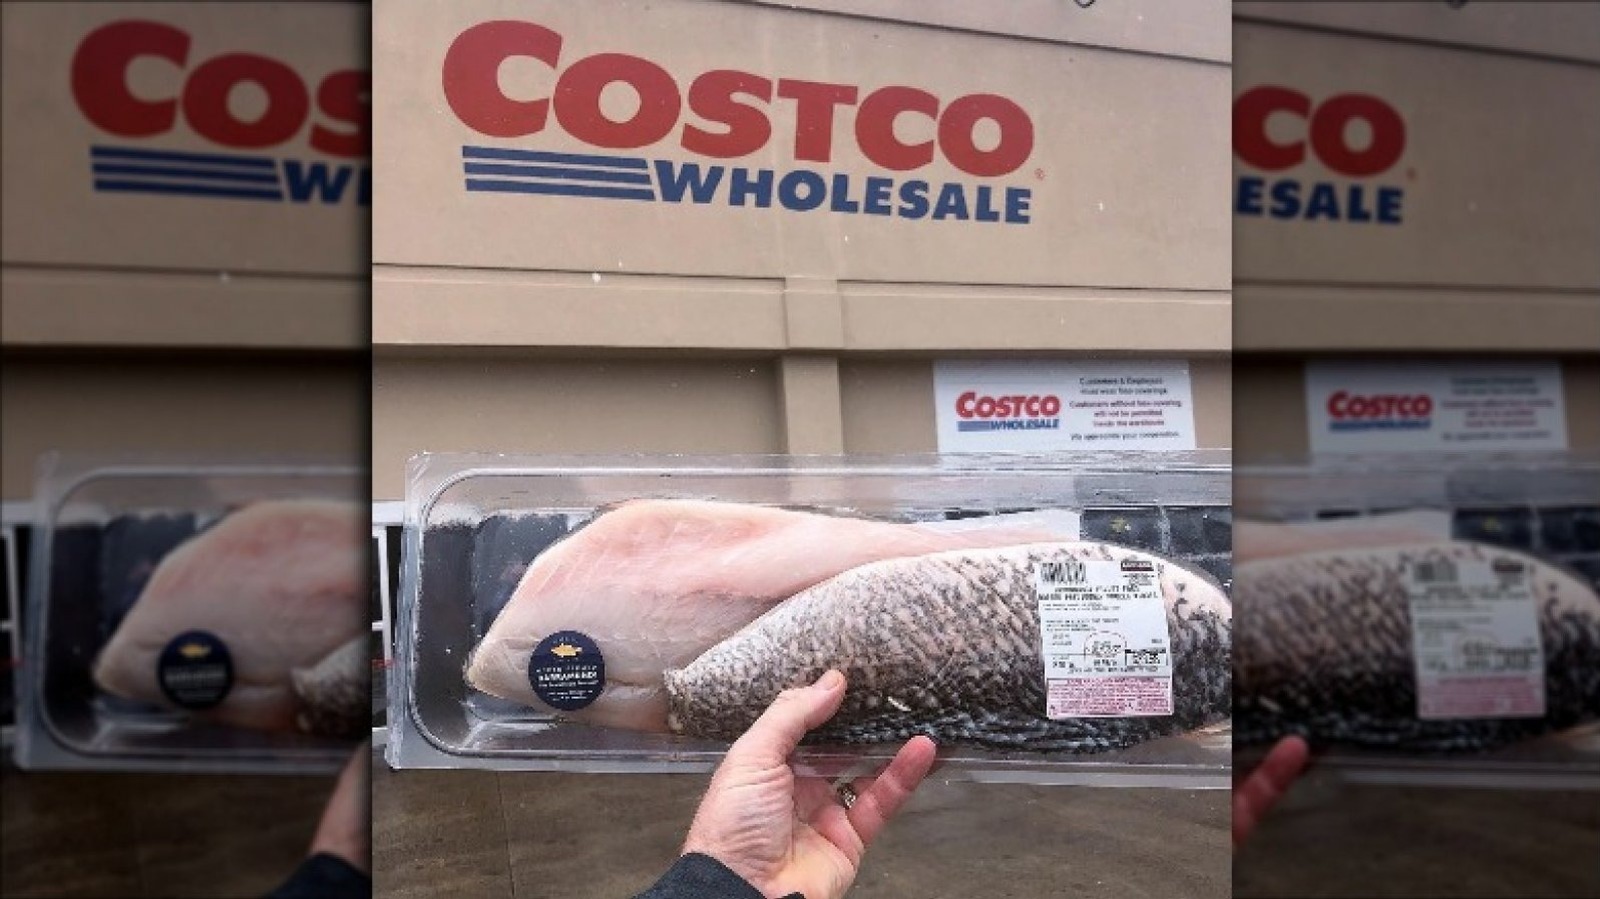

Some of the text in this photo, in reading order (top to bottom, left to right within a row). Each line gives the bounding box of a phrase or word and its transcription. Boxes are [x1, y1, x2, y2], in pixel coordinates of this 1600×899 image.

[442, 20, 1034, 177] COSTCO
[654, 161, 1031, 224] WHOLESALE
[955, 391, 1060, 418] COSTCO
[990, 419, 1060, 430] WHOLESALE
